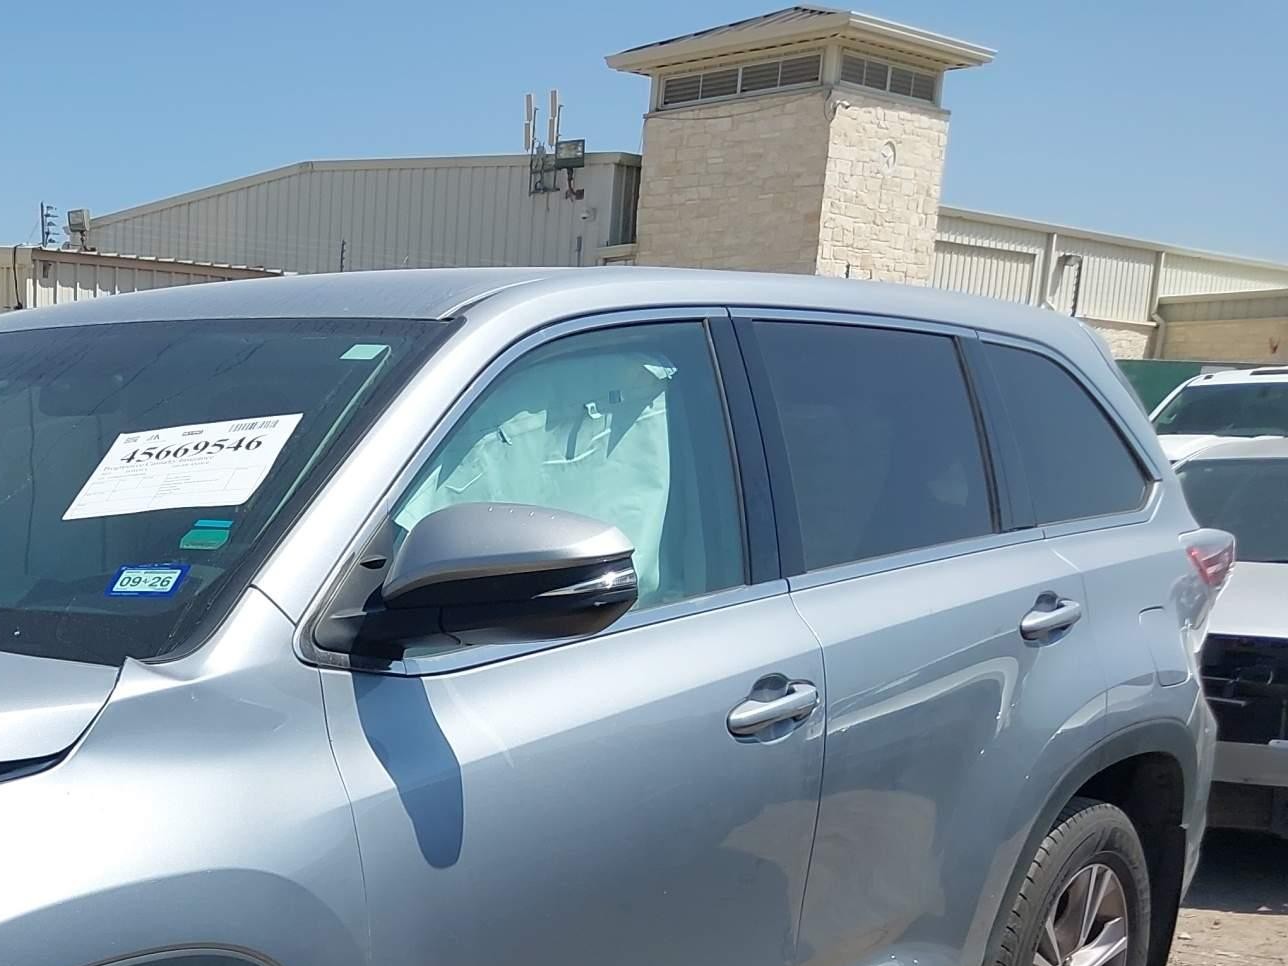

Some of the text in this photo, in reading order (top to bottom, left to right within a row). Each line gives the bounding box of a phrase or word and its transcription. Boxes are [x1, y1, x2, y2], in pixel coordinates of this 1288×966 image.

[119, 434, 268, 464] 45669546
[119, 576, 173, 588] 09 26
